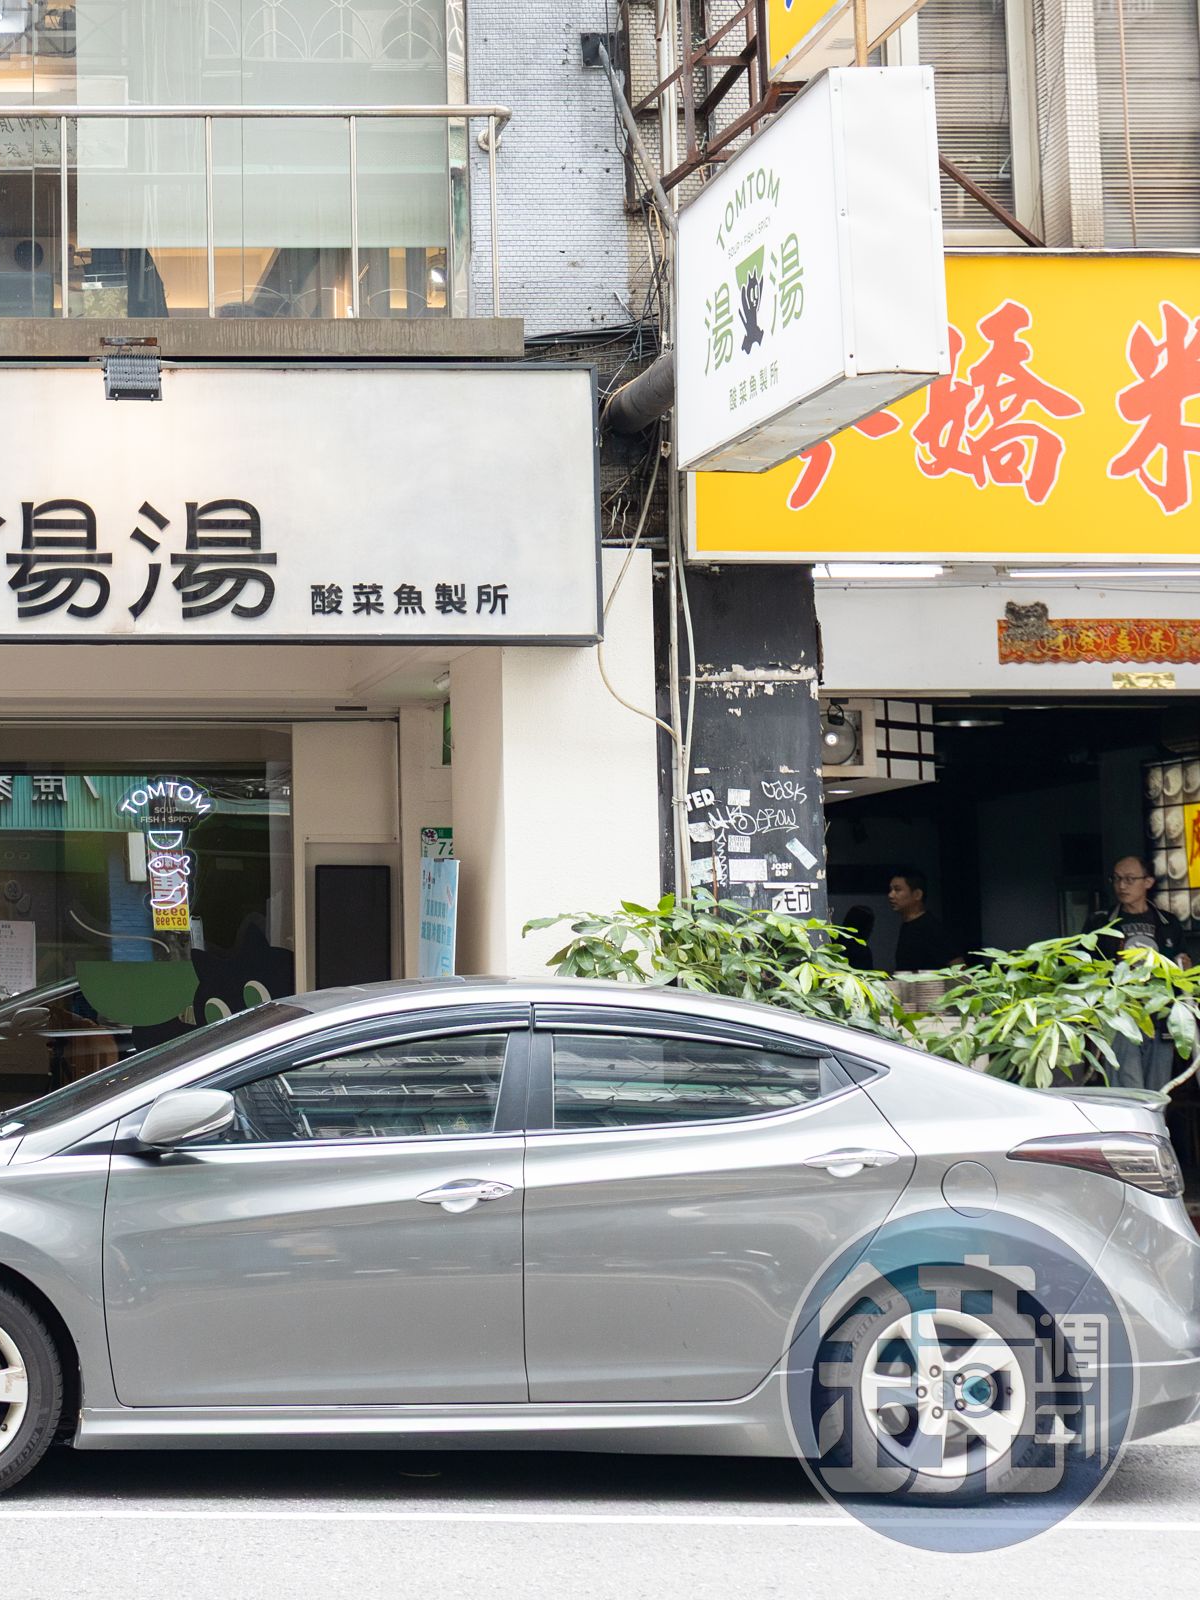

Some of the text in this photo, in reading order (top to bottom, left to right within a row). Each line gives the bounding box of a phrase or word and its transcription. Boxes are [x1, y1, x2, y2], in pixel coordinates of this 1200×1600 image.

[716, 168, 780, 251] TOMTOM
[728, 359, 781, 413] 酸菜魚製所
[309, 582, 510, 616] 酸菜魚製所
[121, 781, 211, 815] TOMTOM
[140, 815, 193, 823] FISH SPICY
[771, 862, 792, 870] JOSH
